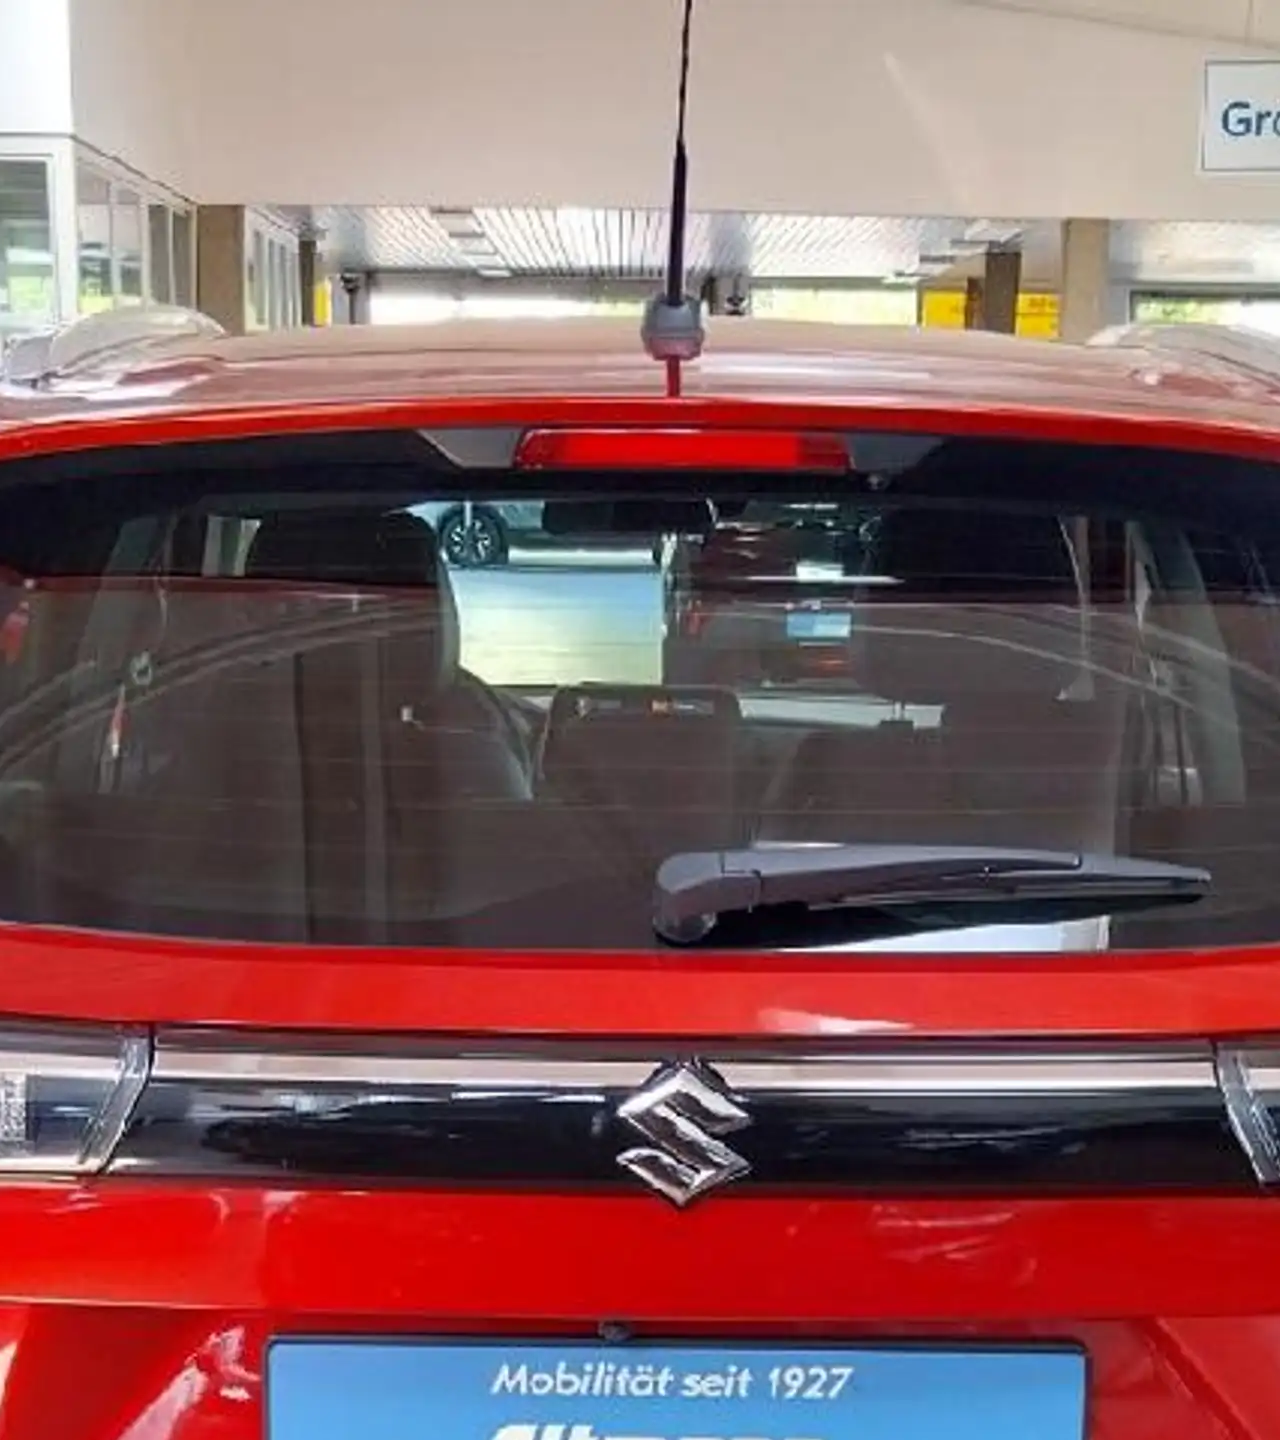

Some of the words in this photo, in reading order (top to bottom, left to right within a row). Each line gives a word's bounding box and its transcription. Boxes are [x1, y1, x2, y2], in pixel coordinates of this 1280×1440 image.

[492, 1362, 673, 1397] Mobilität
[682, 1366, 753, 1398] seit
[768, 1367, 853, 1399] 1927
